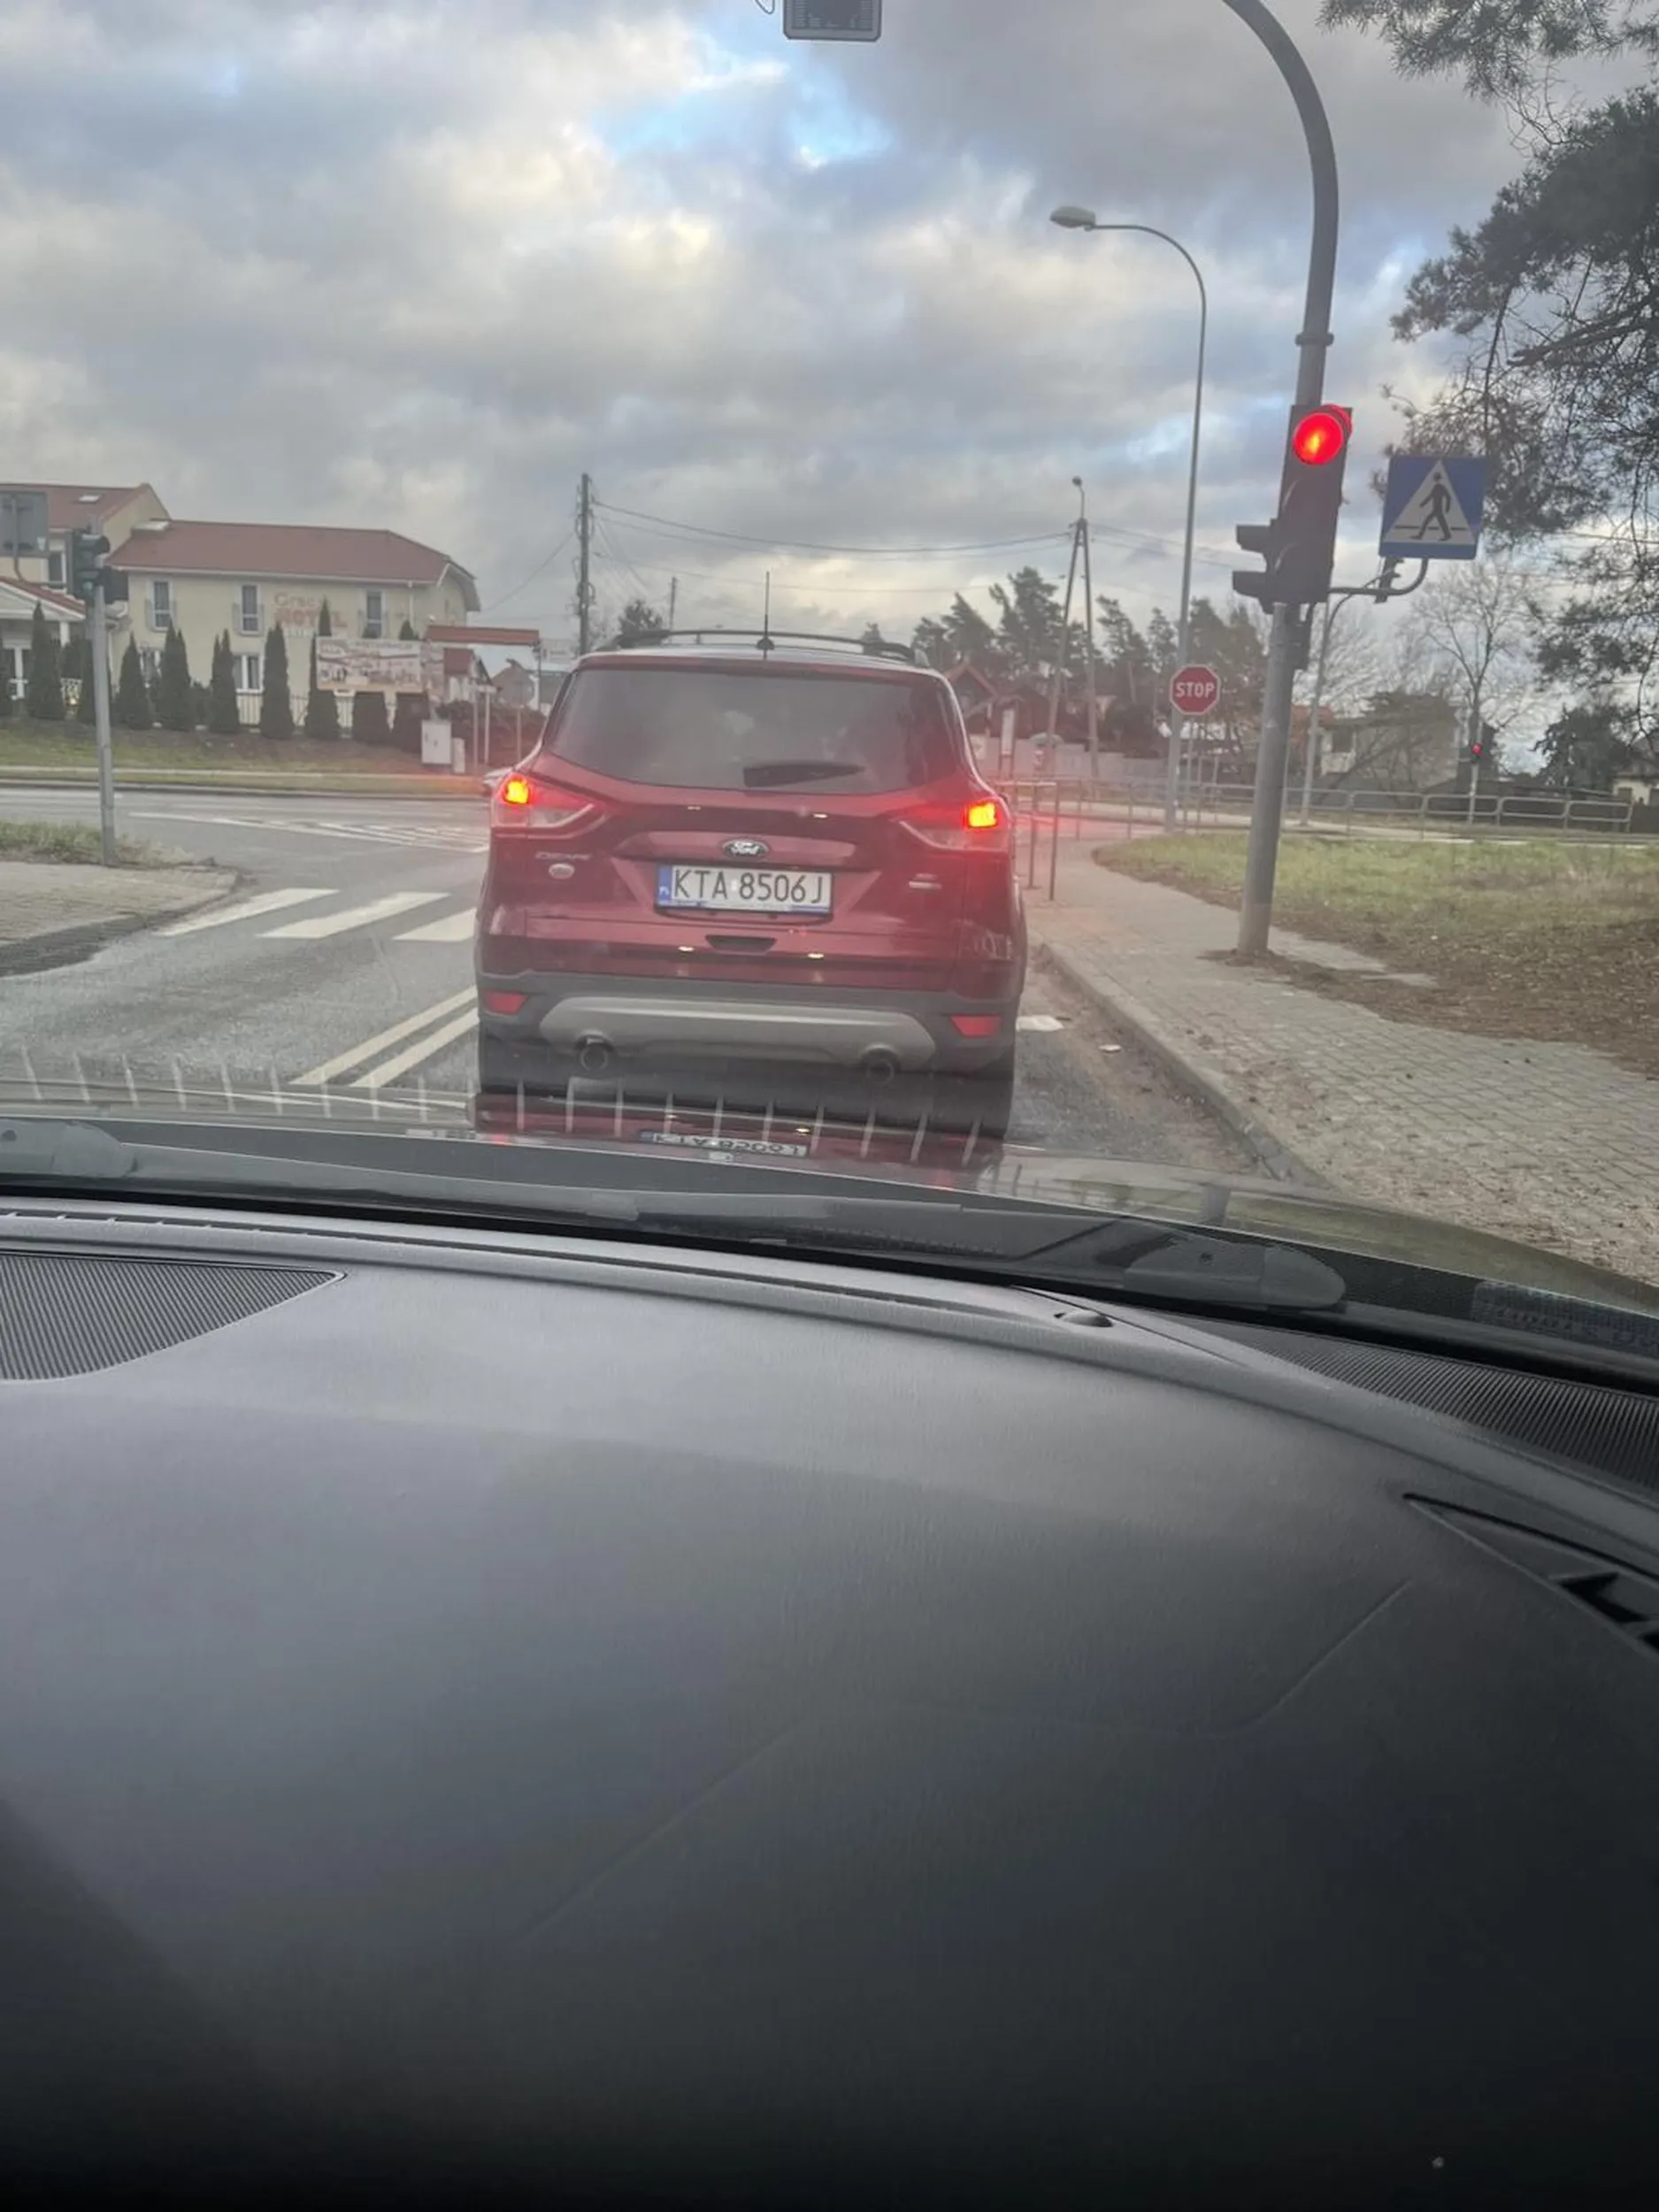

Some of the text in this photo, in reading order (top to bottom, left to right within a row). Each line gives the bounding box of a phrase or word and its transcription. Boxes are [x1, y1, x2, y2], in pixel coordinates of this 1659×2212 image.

[273, 608, 349, 628] HOTL
[1174, 681, 1216, 698] STOP
[673, 869, 824, 904] KTA 8506J
